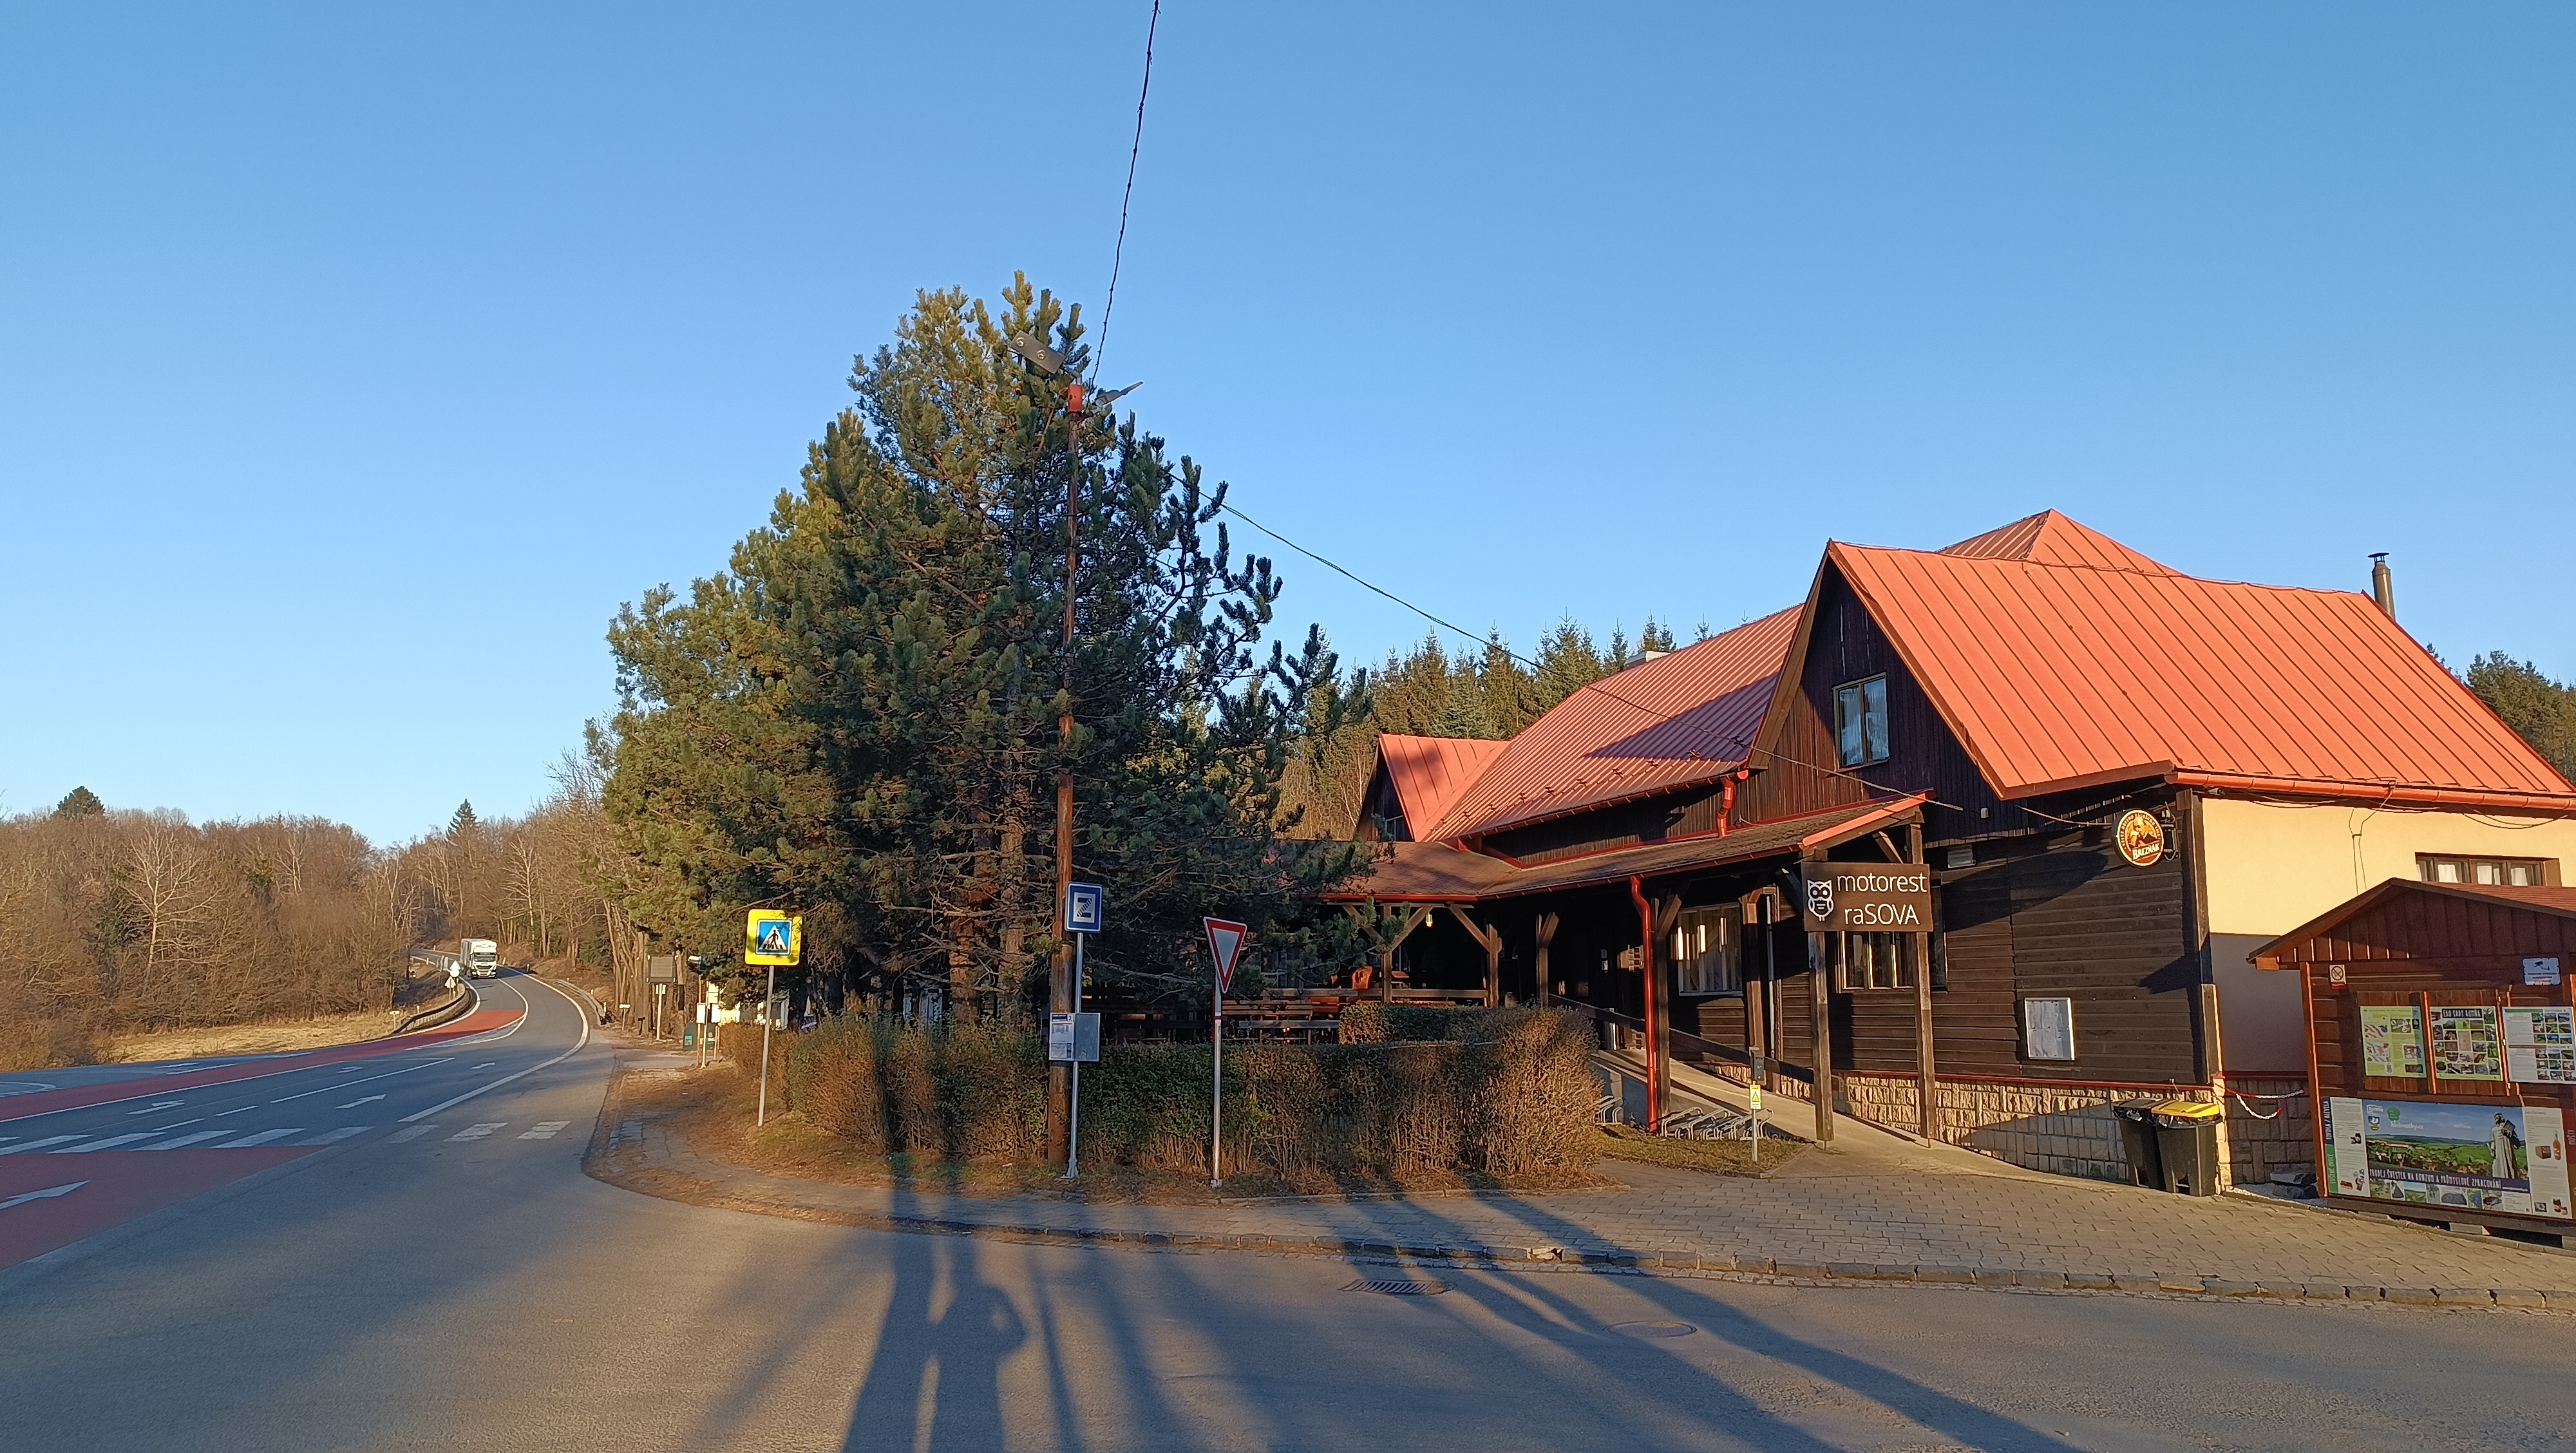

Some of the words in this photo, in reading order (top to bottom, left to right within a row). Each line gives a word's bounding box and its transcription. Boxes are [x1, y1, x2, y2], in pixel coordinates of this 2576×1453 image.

[1837, 872, 1927, 893] motorest
[1844, 904, 1920, 925] raSOVA
[2369, 1168, 2385, 1178] PRODEJ
[2387, 1168, 2406, 1180] ŠVESTEK
[2407, 1172, 2414, 1181] NA
